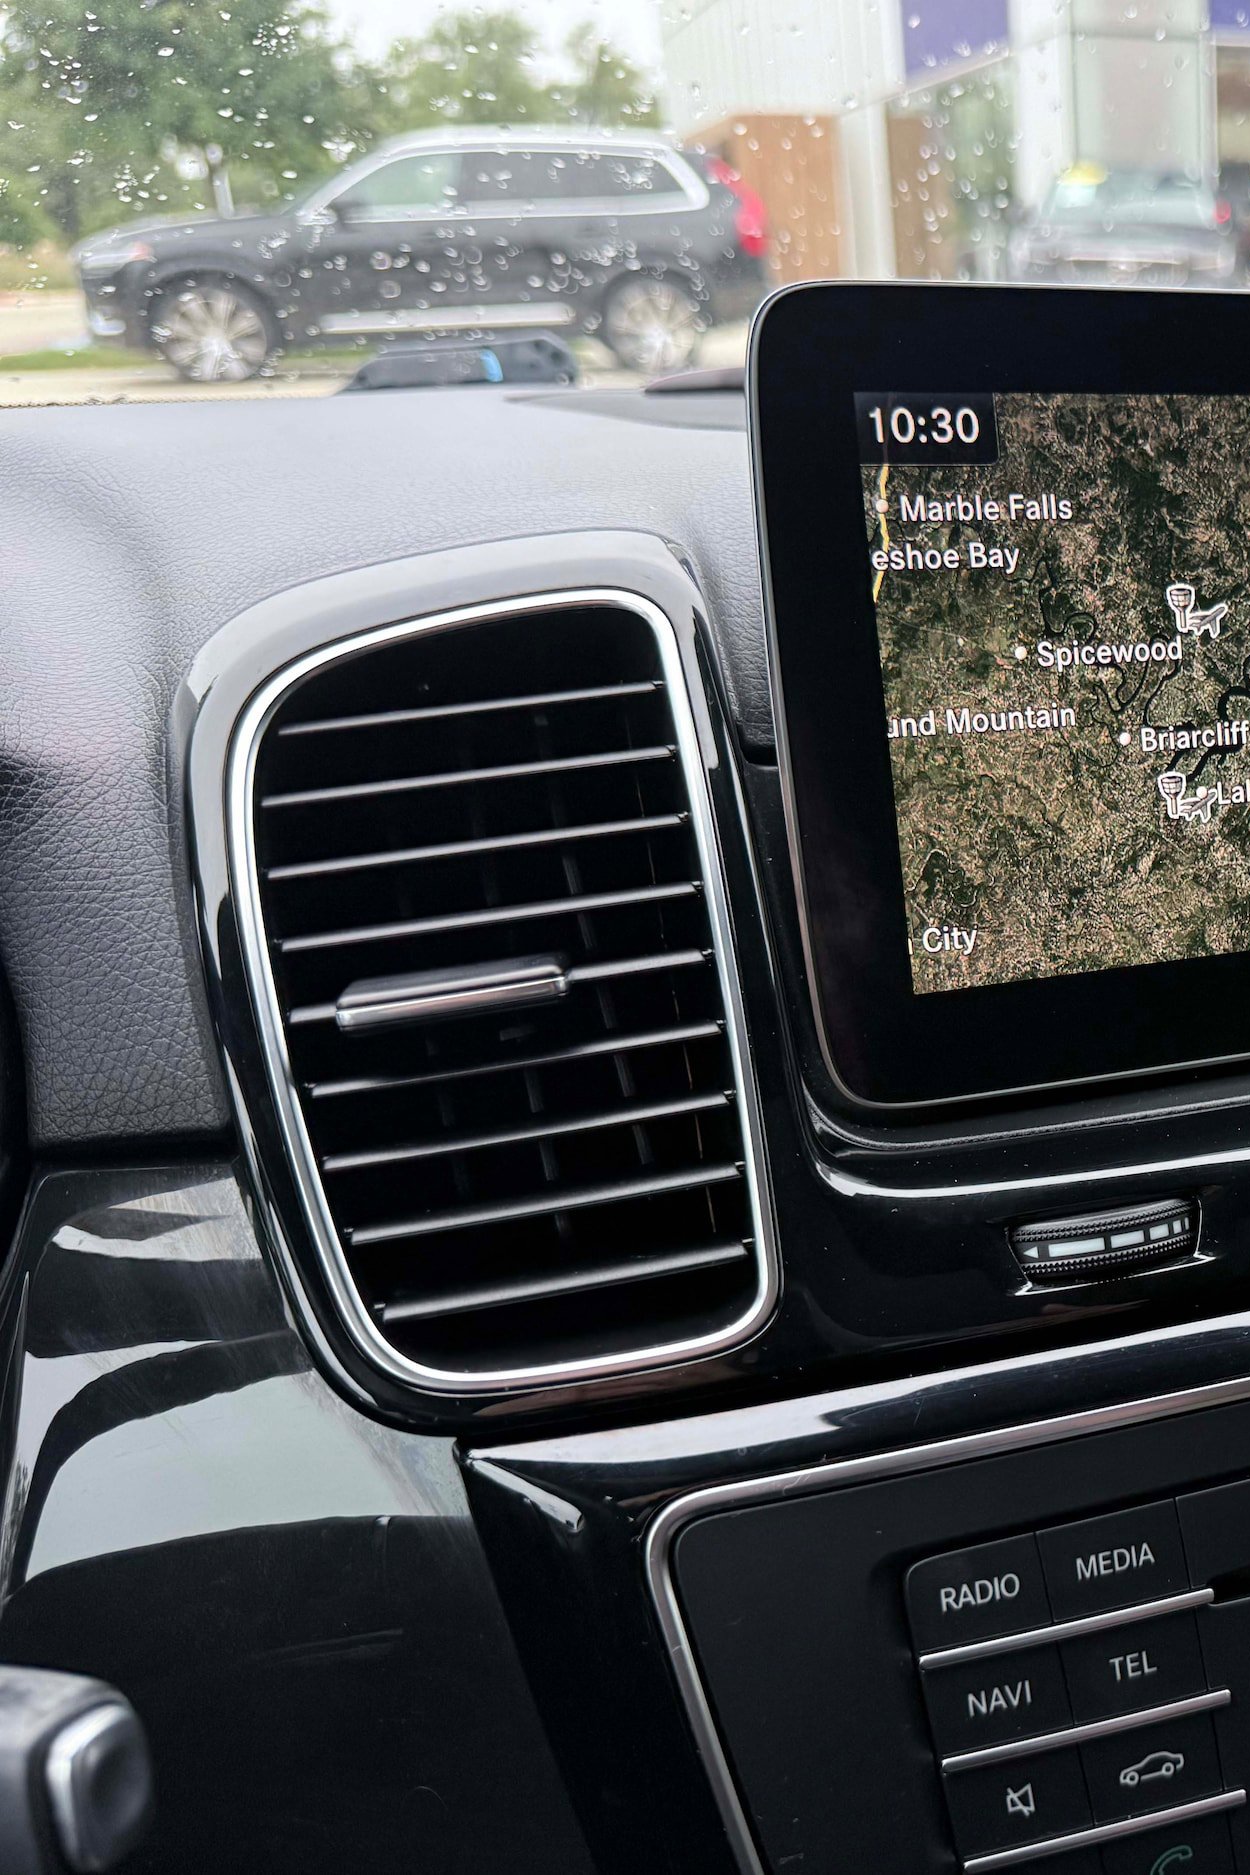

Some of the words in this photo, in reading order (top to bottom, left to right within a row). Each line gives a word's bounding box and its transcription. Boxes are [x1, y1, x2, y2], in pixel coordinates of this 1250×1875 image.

[868, 405, 980, 444] 10:30
[900, 494, 1000, 522] Marble
[1008, 493, 1073, 521] Falls
[872, 543, 960, 571] eshoe
[969, 541, 1020, 574] Bay
[1037, 636, 1183, 671] Spicewood
[946, 703, 1077, 735] Mountain
[1141, 720, 1250, 752] Briarcliff
[922, 925, 978, 956] City
[1075, 1541, 1156, 1582] MEDIA
[940, 1572, 1021, 1613] RADIO
[1108, 1650, 1158, 1682] TEL
[966, 1679, 1033, 1719] NAVI
